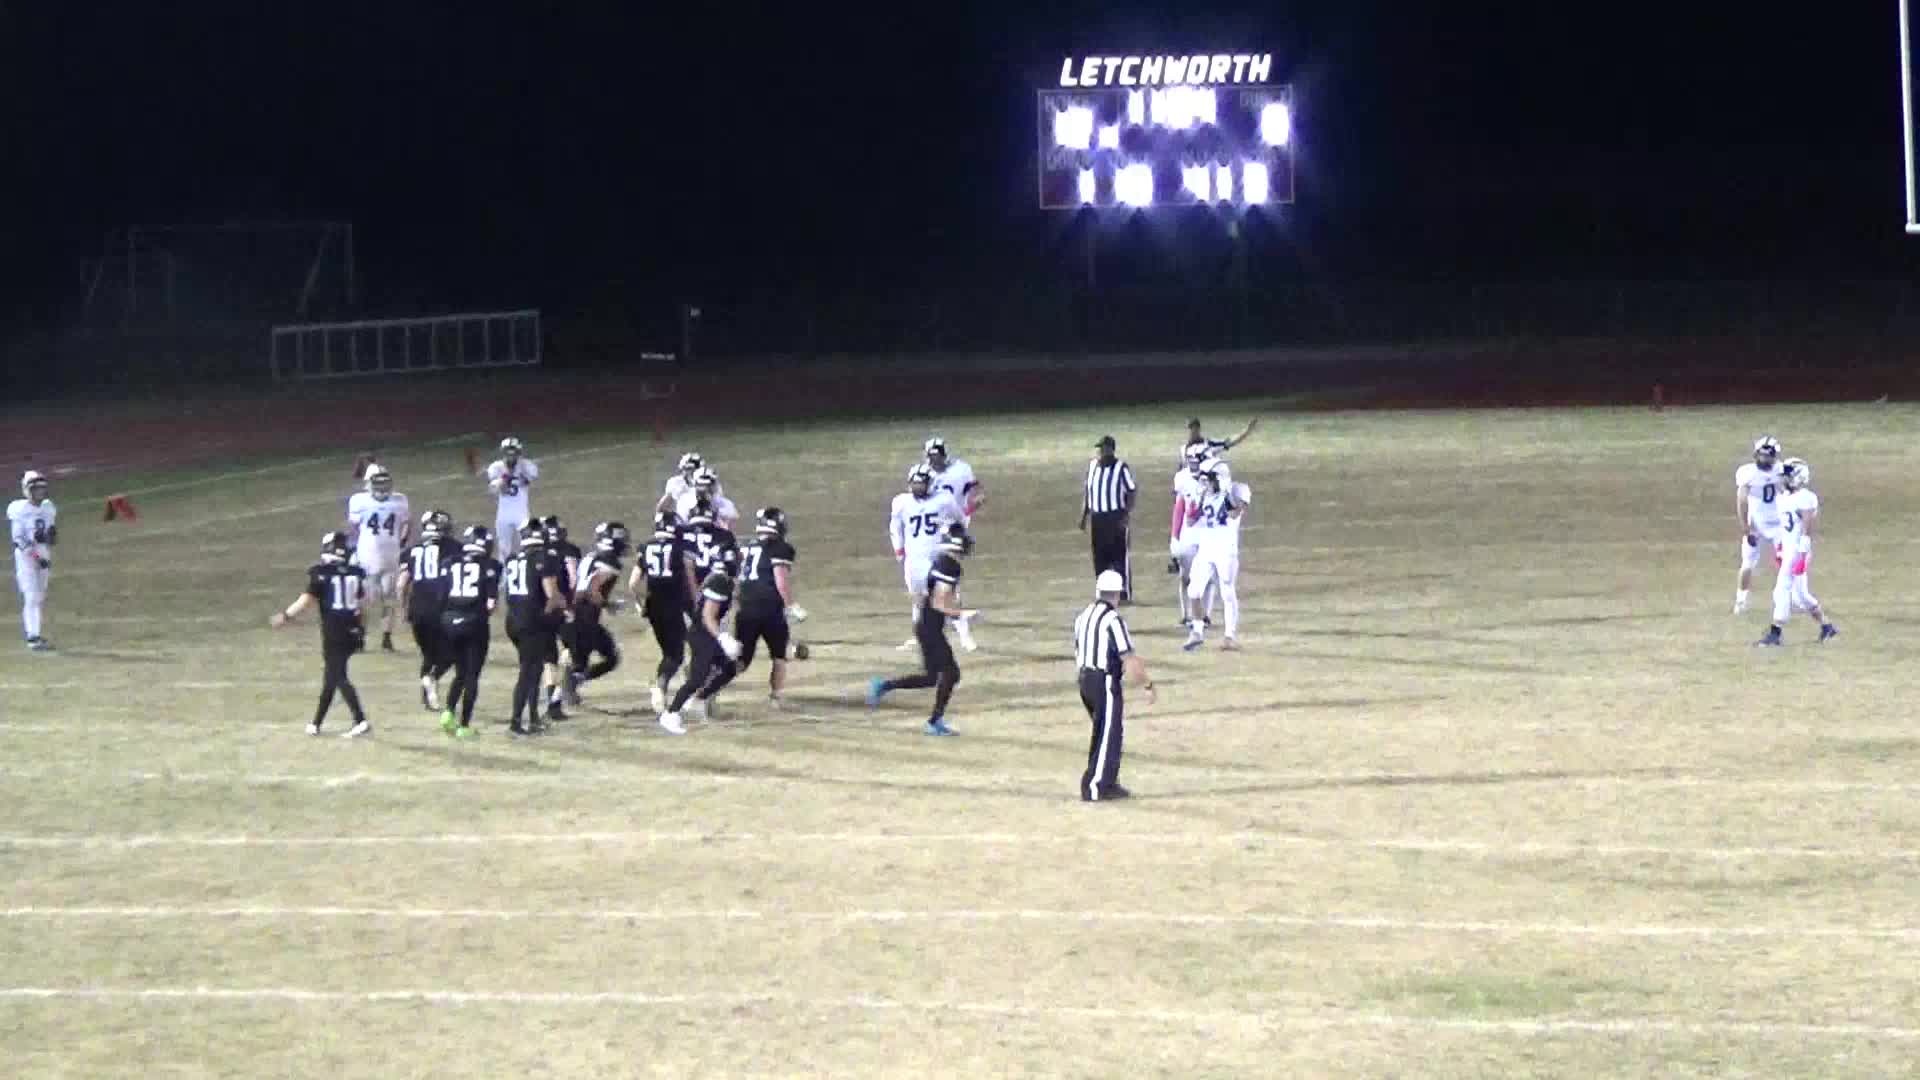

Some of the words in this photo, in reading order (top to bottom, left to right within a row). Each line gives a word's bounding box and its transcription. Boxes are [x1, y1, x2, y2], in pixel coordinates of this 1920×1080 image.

[1060, 54, 1272, 87] LETCHWORTH
[1763, 483, 1776, 503] 0
[366, 511, 397, 537] 44
[909, 512, 940, 538] 75
[506, 558, 529, 595] 21
[645, 544, 673, 577] 51
[330, 574, 361, 611] 10
[449, 561, 482, 597] 12
